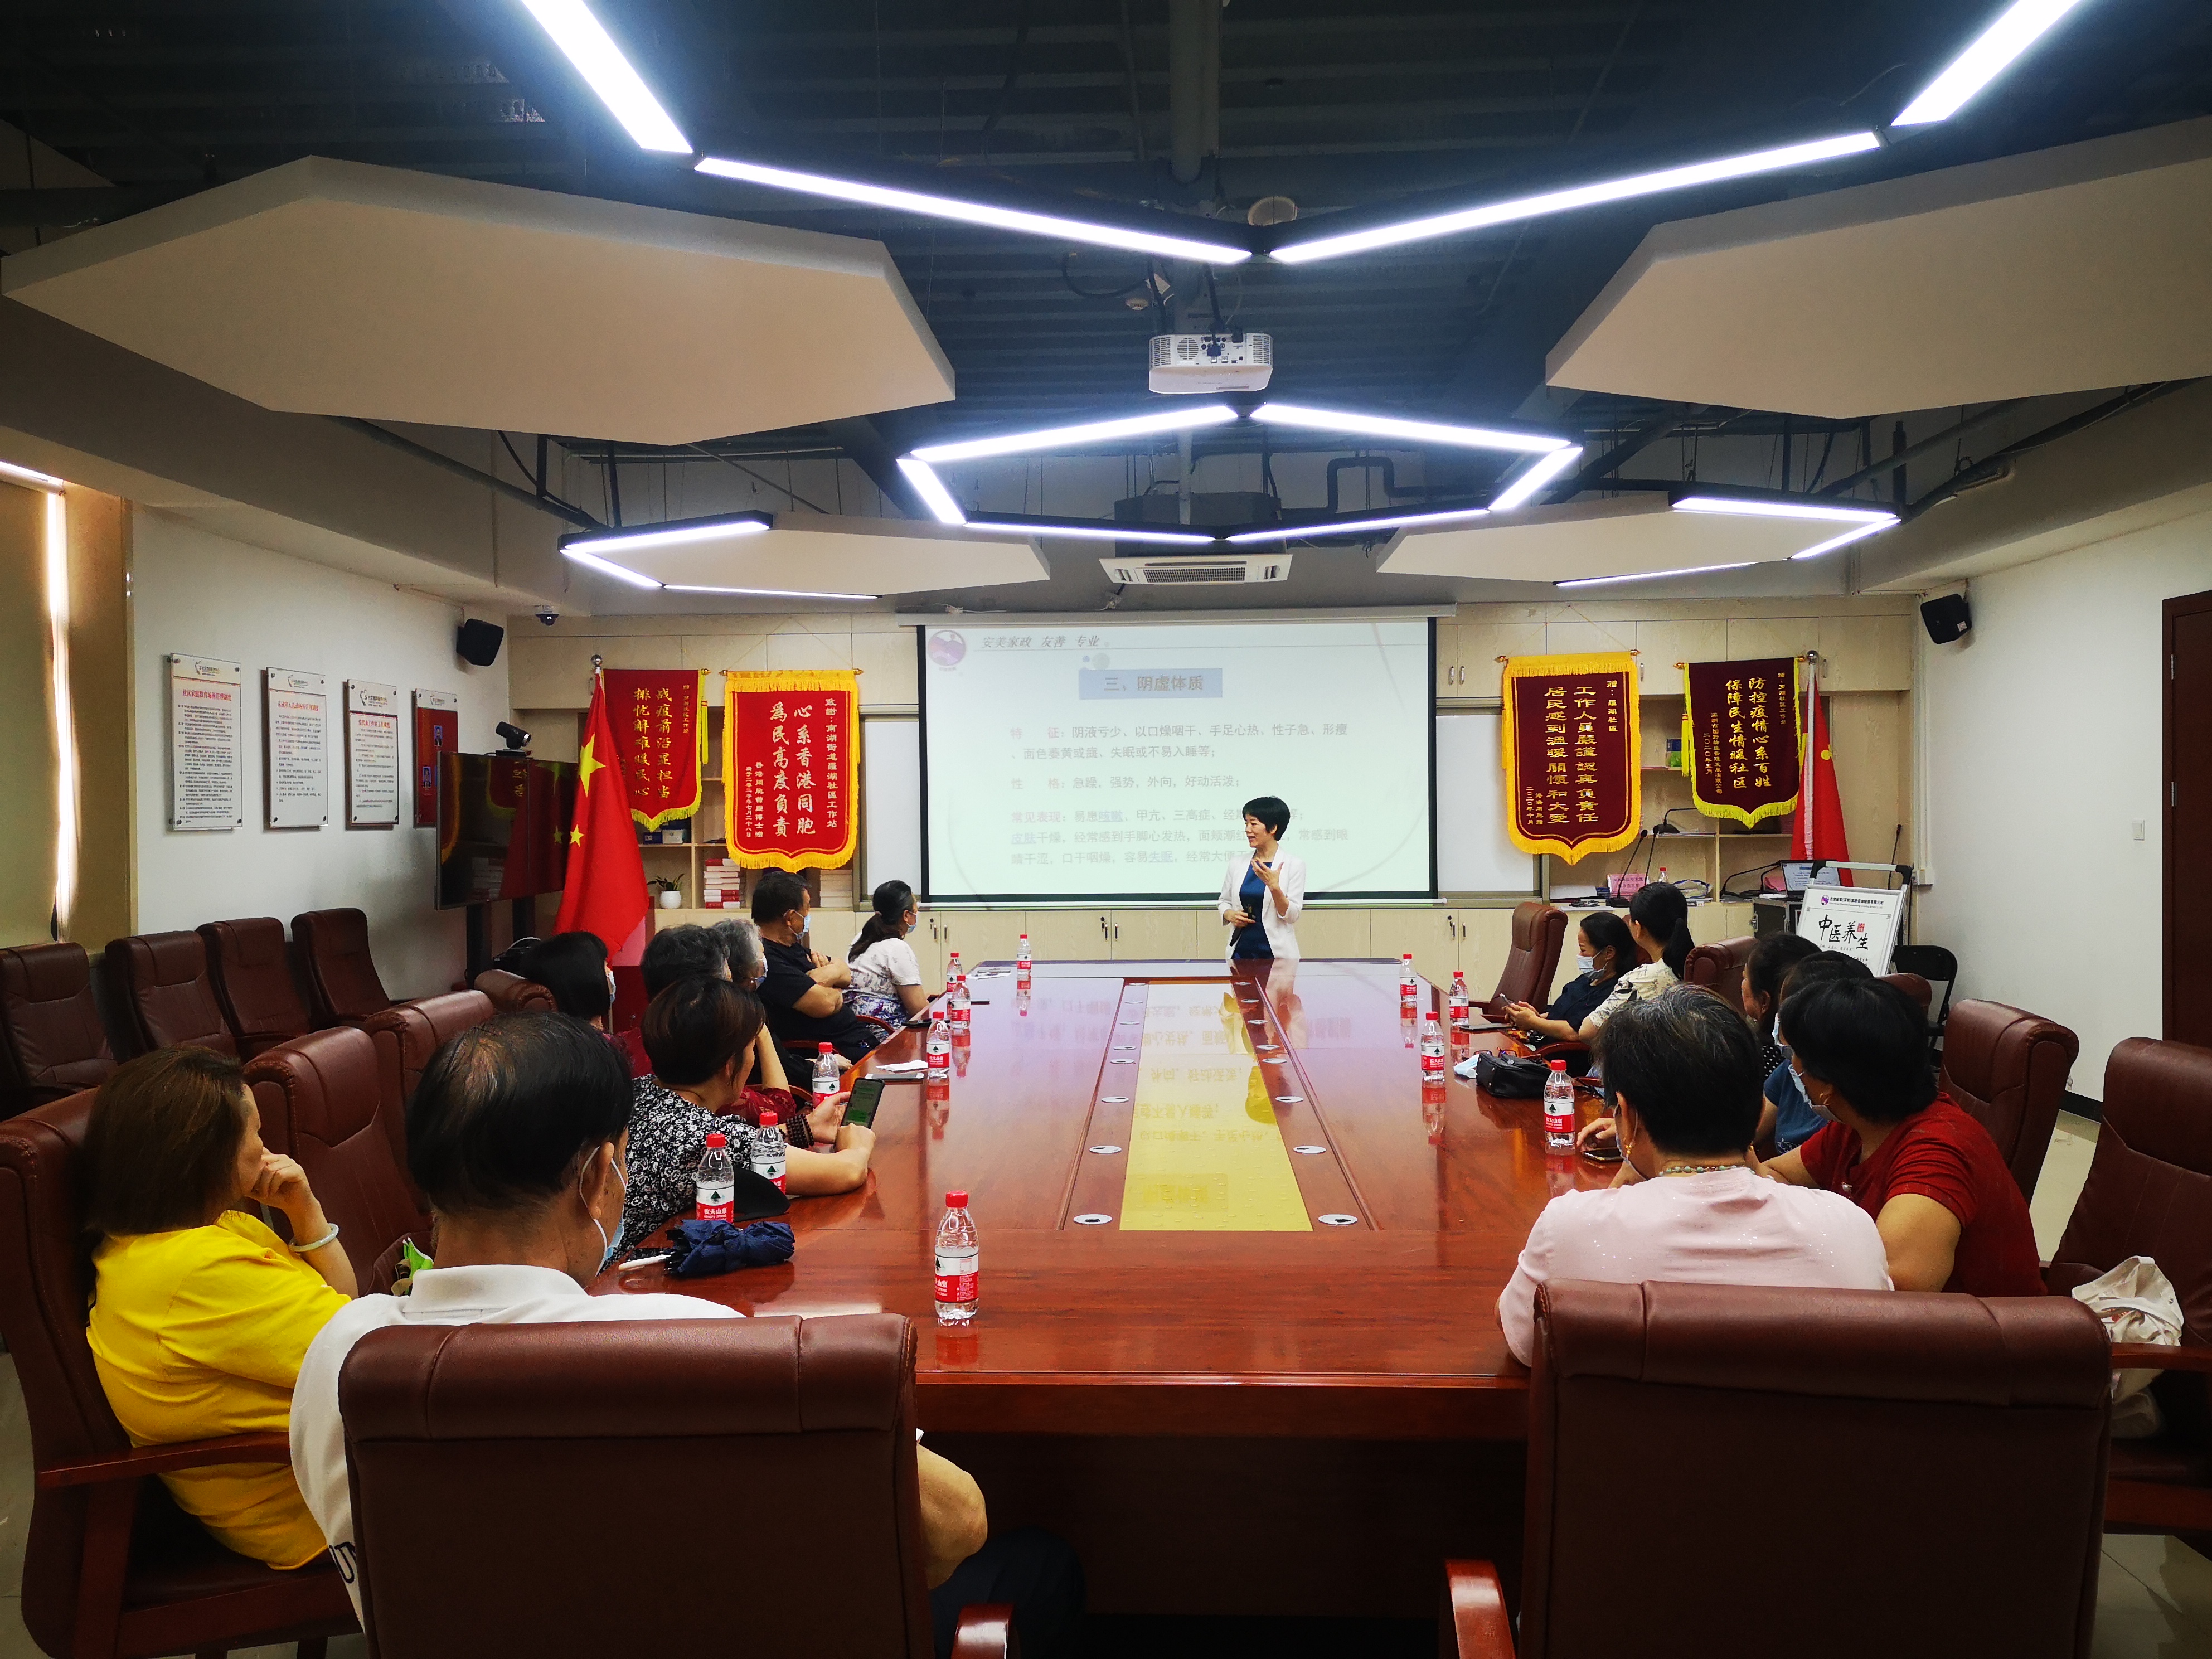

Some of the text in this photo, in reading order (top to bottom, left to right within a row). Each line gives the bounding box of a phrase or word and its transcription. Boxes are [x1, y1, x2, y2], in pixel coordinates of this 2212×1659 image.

[1040, 635, 1066, 648] 友善
[1076, 634, 1100, 647] 专业
[794, 705, 817, 835] 心系香港同胞
[1725, 679, 1749, 789] 保障民生情暖社区
[1748, 677, 1772, 787] 防控疫情心系百姓
[1818, 914, 1869, 950] 中医养生
